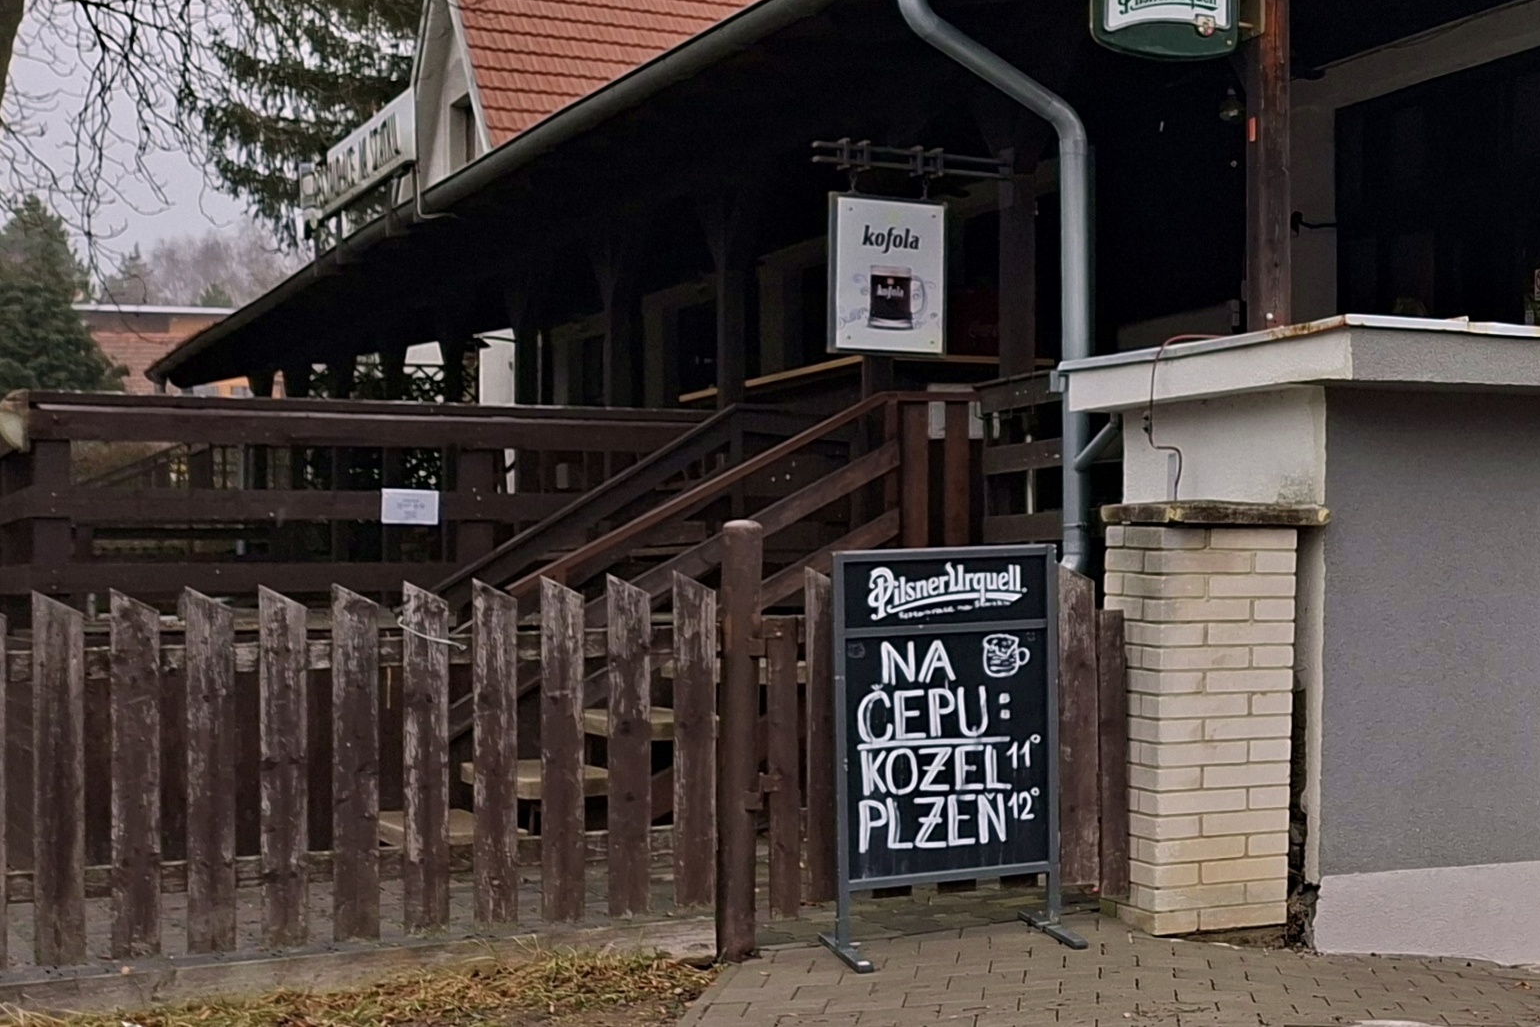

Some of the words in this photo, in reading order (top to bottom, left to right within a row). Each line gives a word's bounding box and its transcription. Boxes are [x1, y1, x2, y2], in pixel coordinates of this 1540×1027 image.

[861, 224, 921, 254] kofola
[867, 566, 949, 621] Pilsner
[881, 639, 956, 685] NA
[860, 744, 1012, 796] KOZEL
[858, 792, 1007, 854] PLZEŇ
